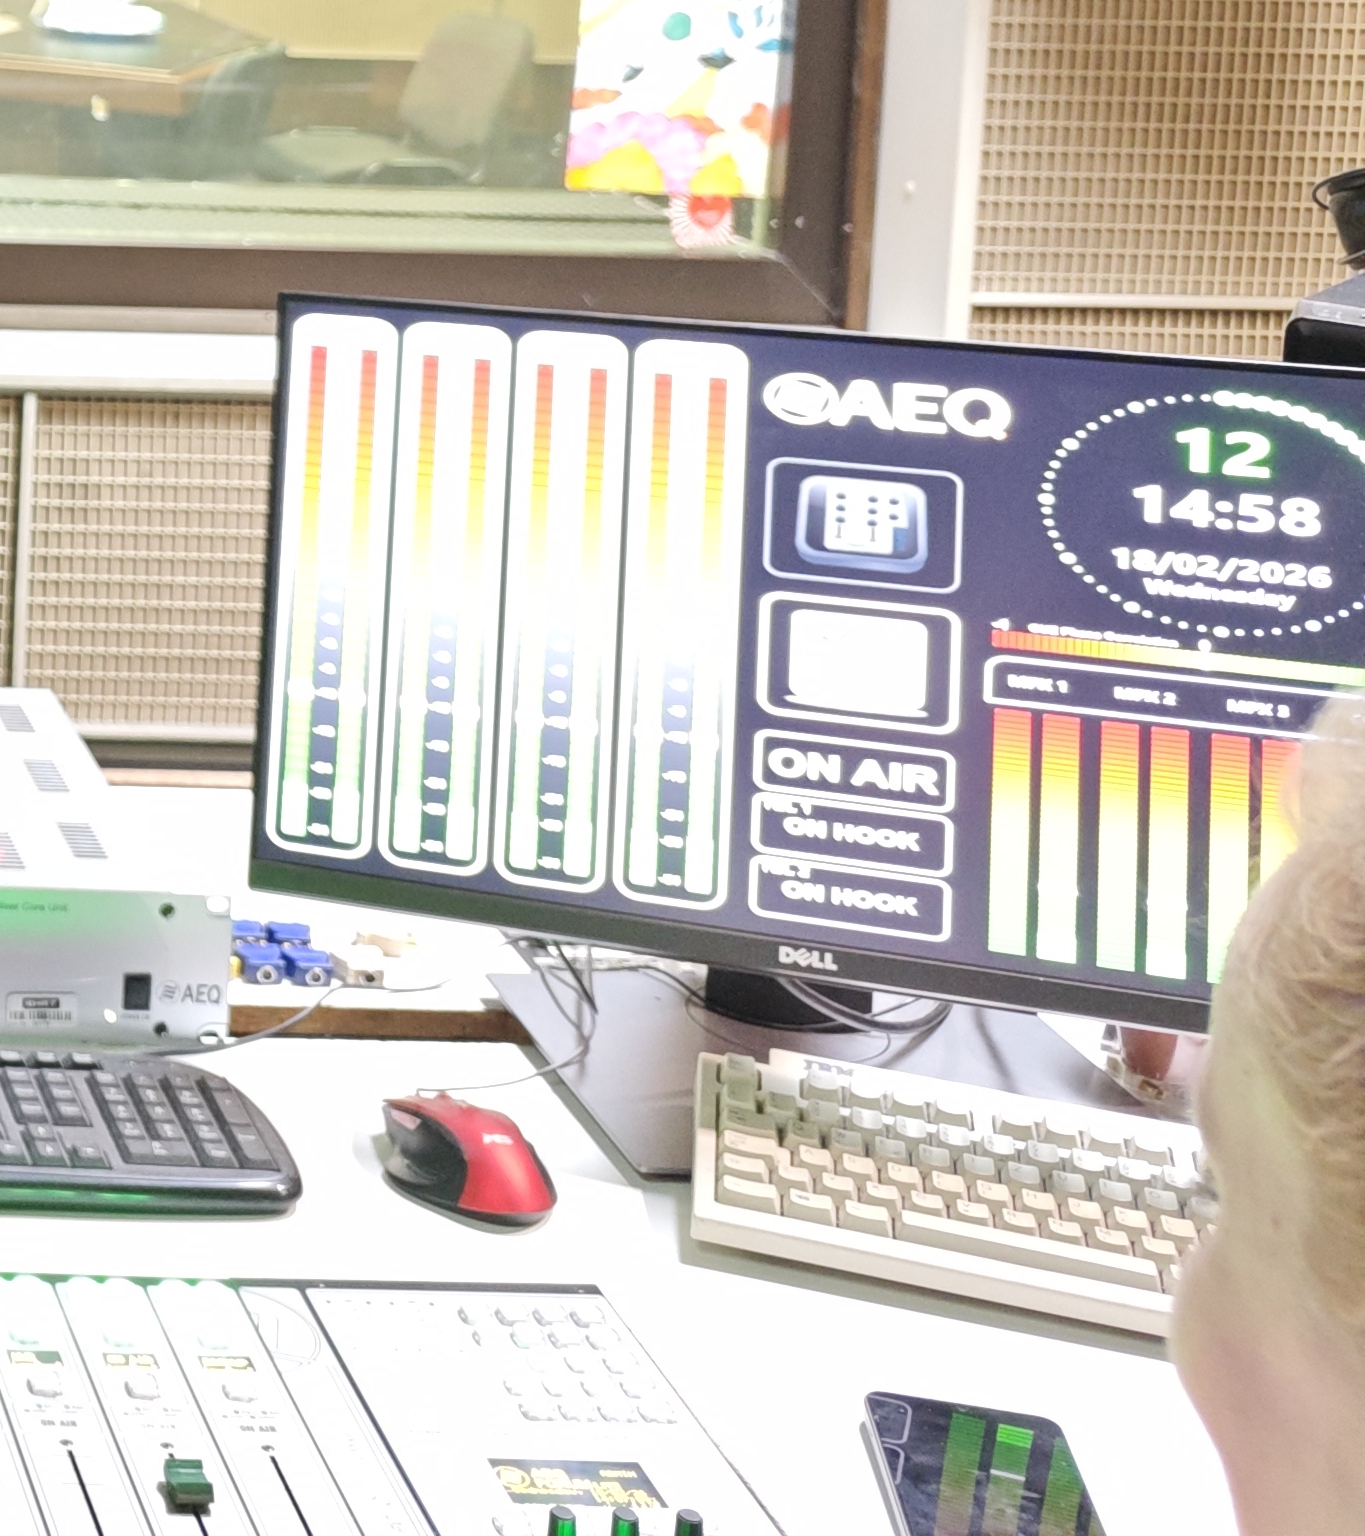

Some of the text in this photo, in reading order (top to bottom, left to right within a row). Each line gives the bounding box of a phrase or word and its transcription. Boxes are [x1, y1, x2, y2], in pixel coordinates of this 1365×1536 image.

[828, 378, 1013, 441] AEQ
[1175, 426, 1274, 480] 12
[1132, 484, 1322, 538] 14:58
[1111, 546, 1334, 590] 18/02/2026
[1142, 577, 1298, 614] Wednesday
[768, 747, 941, 797] ON AIR
[782, 816, 921, 852] ON HOOK
[780, 879, 920, 917] ON HOOK
[778, 945, 839, 972] DELL
[180, 983, 222, 1005] AEQ
